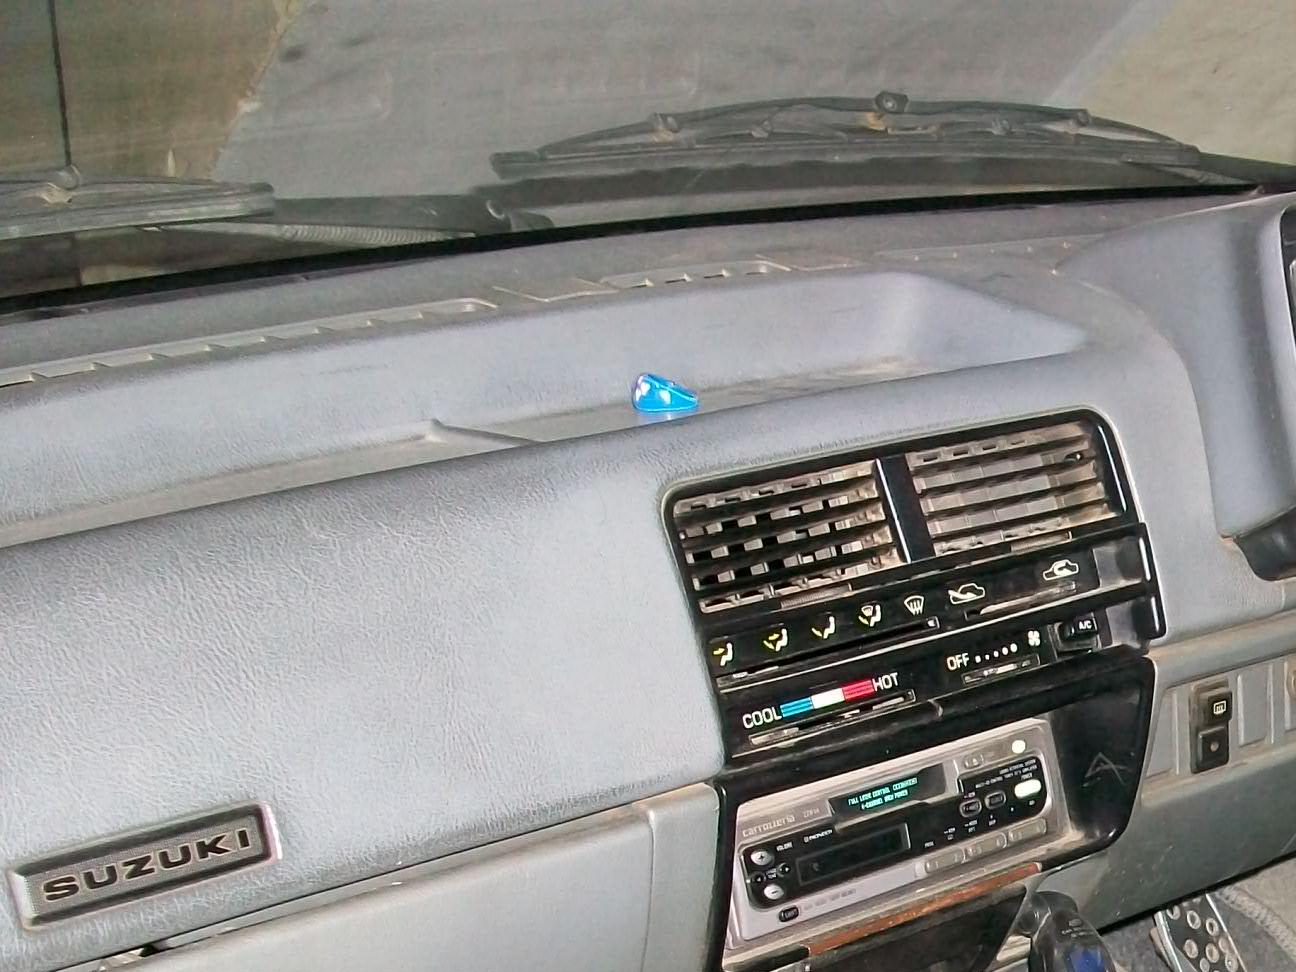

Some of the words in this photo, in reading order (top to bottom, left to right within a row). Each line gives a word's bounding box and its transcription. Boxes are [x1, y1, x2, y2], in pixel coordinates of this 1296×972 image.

[1078, 619, 1092, 630] A/C
[946, 652, 970, 671] OFF
[871, 672, 899, 692] HOT
[742, 706, 783, 729] COOL
[42, 828, 252, 903] SUZUKI
